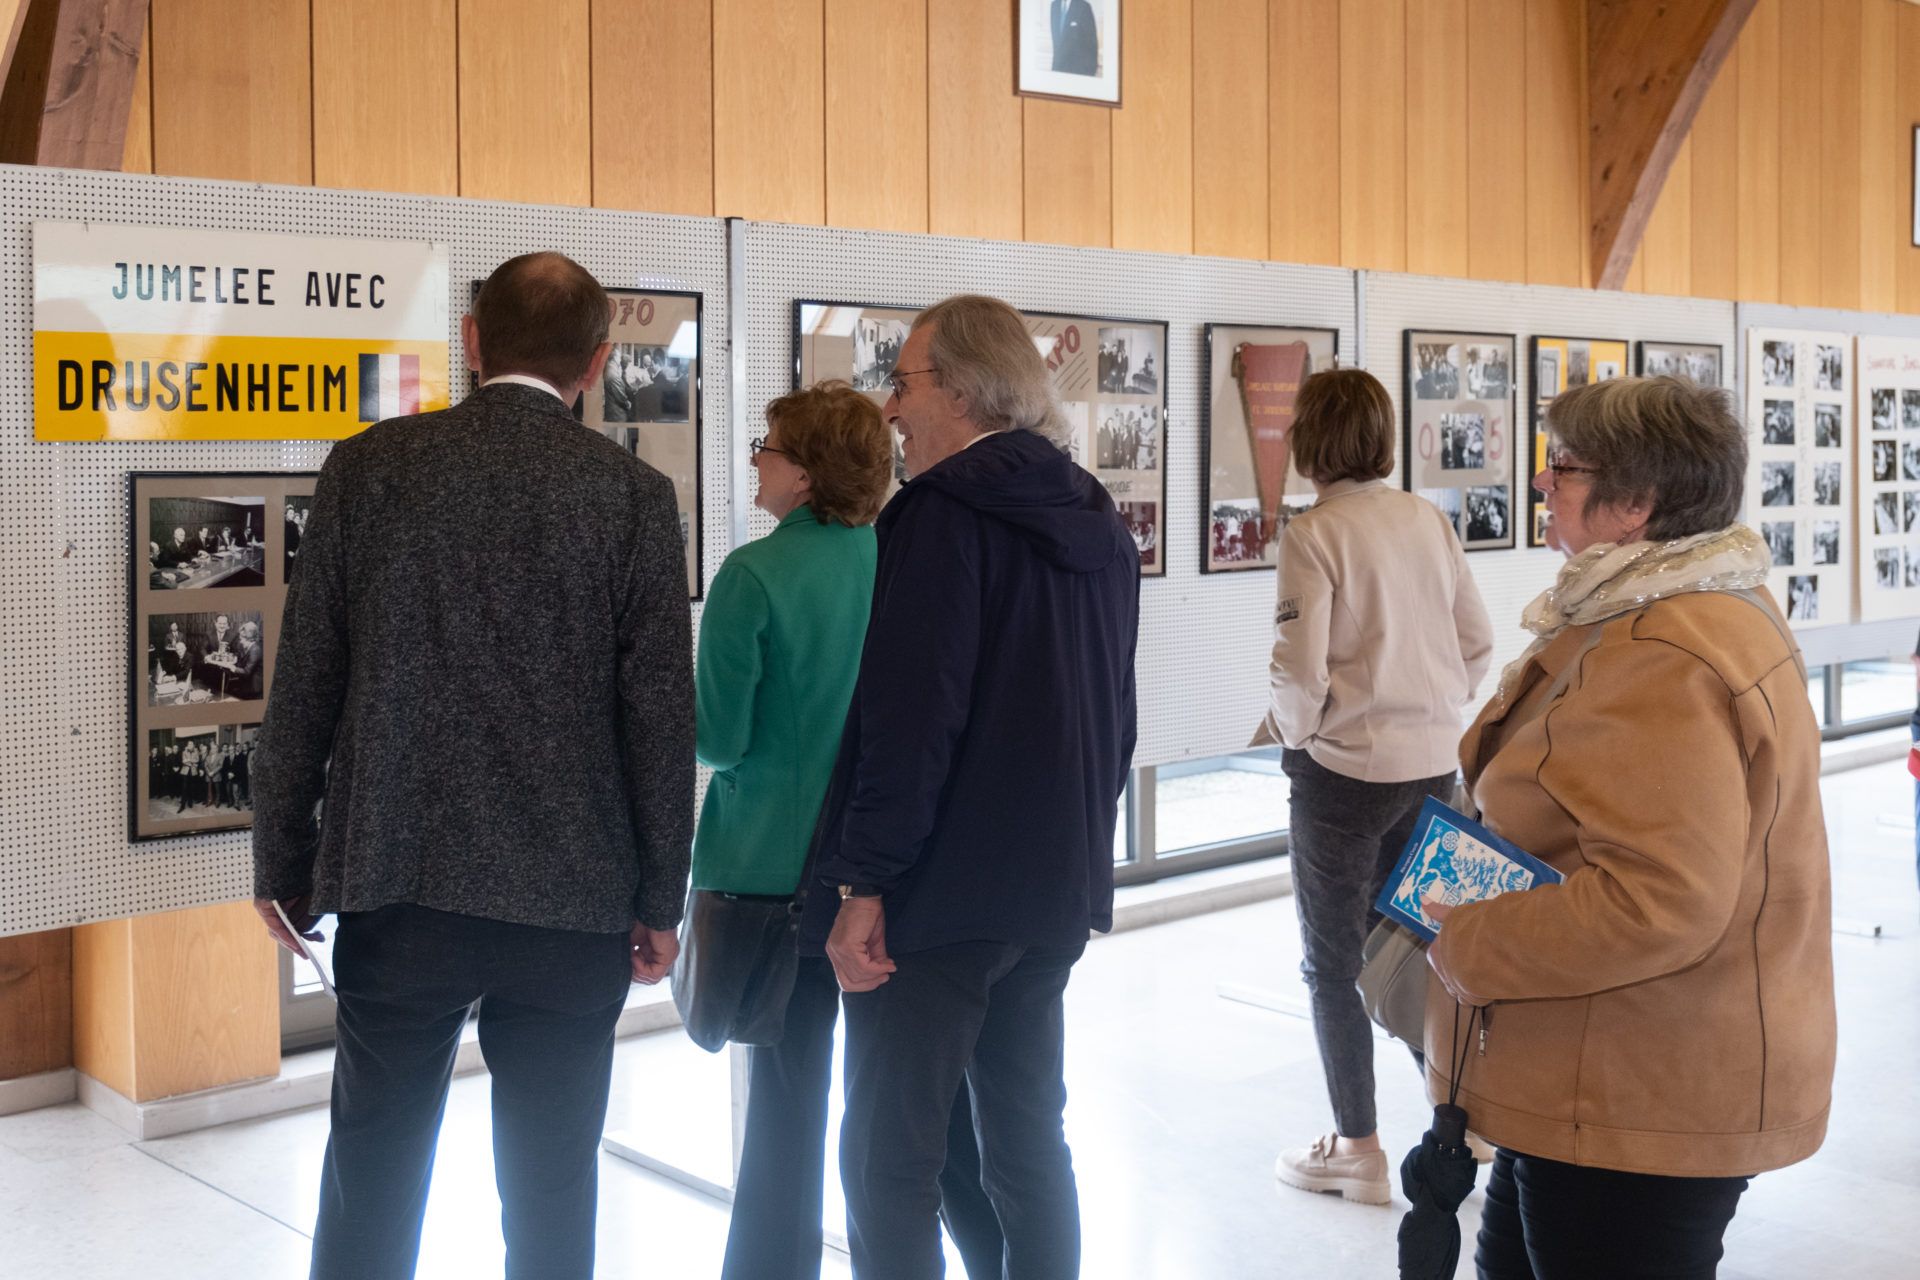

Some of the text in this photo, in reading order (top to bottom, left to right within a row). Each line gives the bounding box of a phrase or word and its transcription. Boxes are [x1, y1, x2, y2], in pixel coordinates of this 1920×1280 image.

[113, 262, 386, 309] JUMELEE AVEC
[58, 360, 347, 411] DRUSENHEIM
